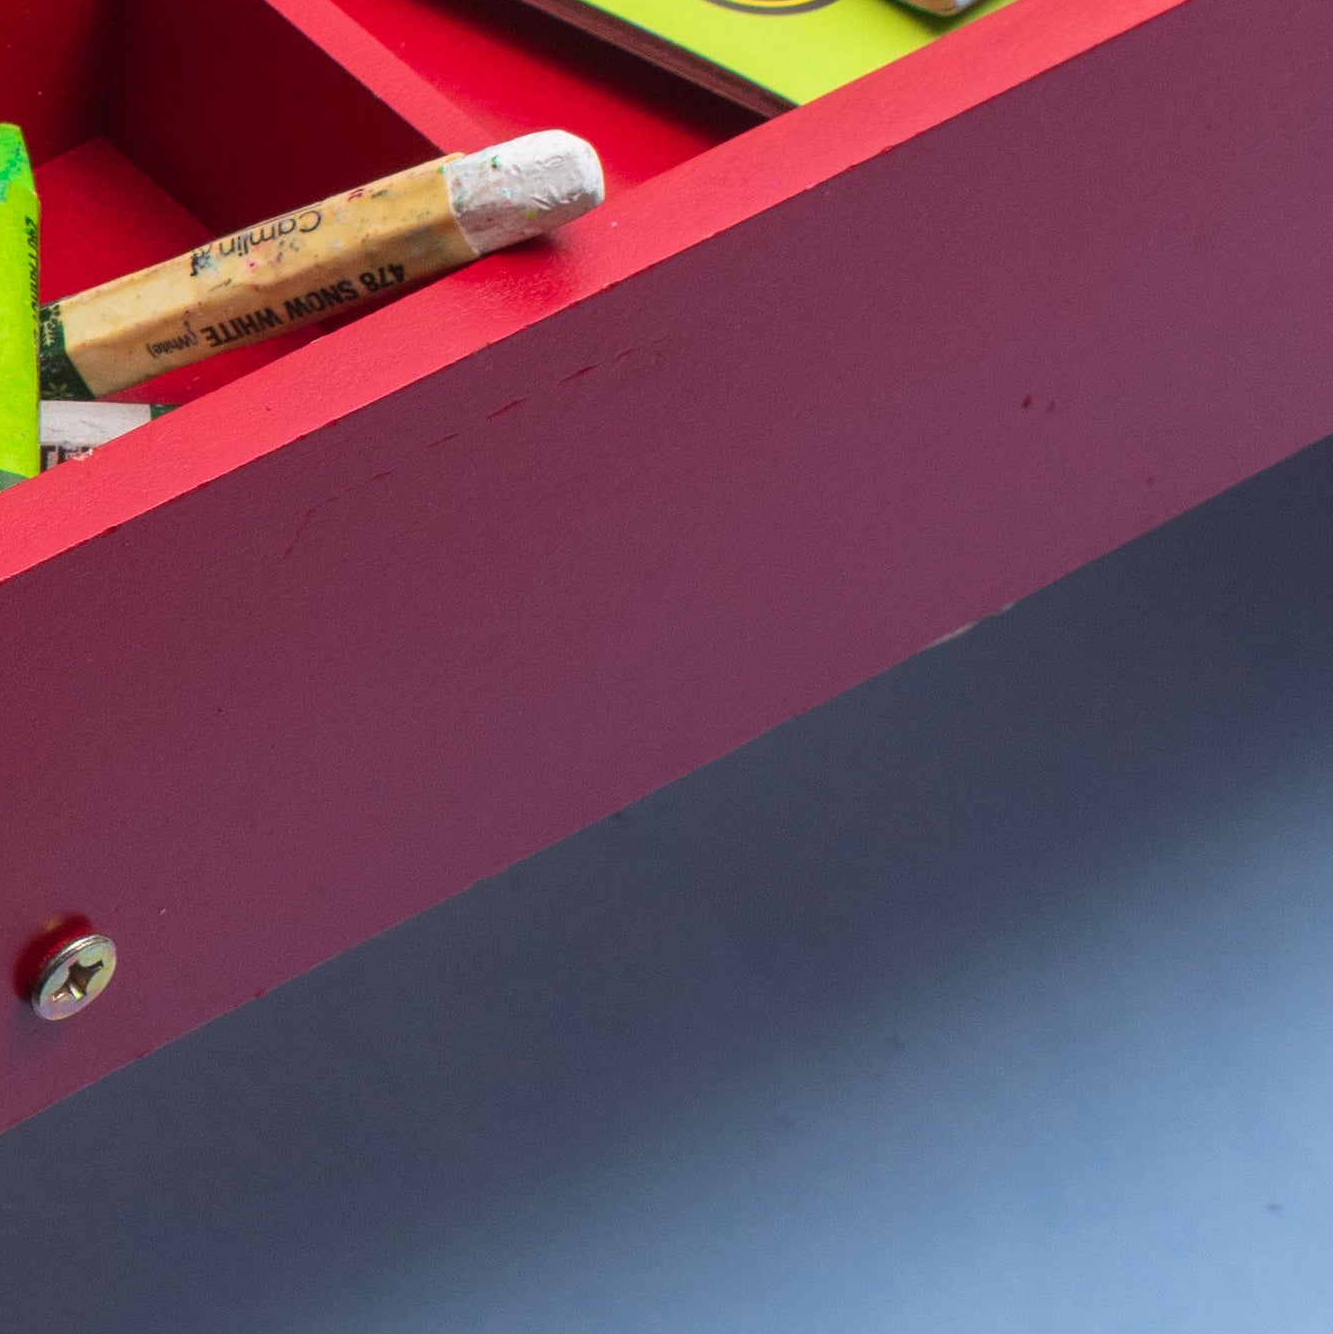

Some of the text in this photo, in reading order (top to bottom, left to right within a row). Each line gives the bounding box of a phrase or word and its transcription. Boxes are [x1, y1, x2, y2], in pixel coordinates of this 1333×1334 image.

[219, 209, 323, 257] Camlin
[283, 279, 359, 315] SNOW
[359, 263, 406, 292] 478
[200, 306, 283, 349] WHITE
